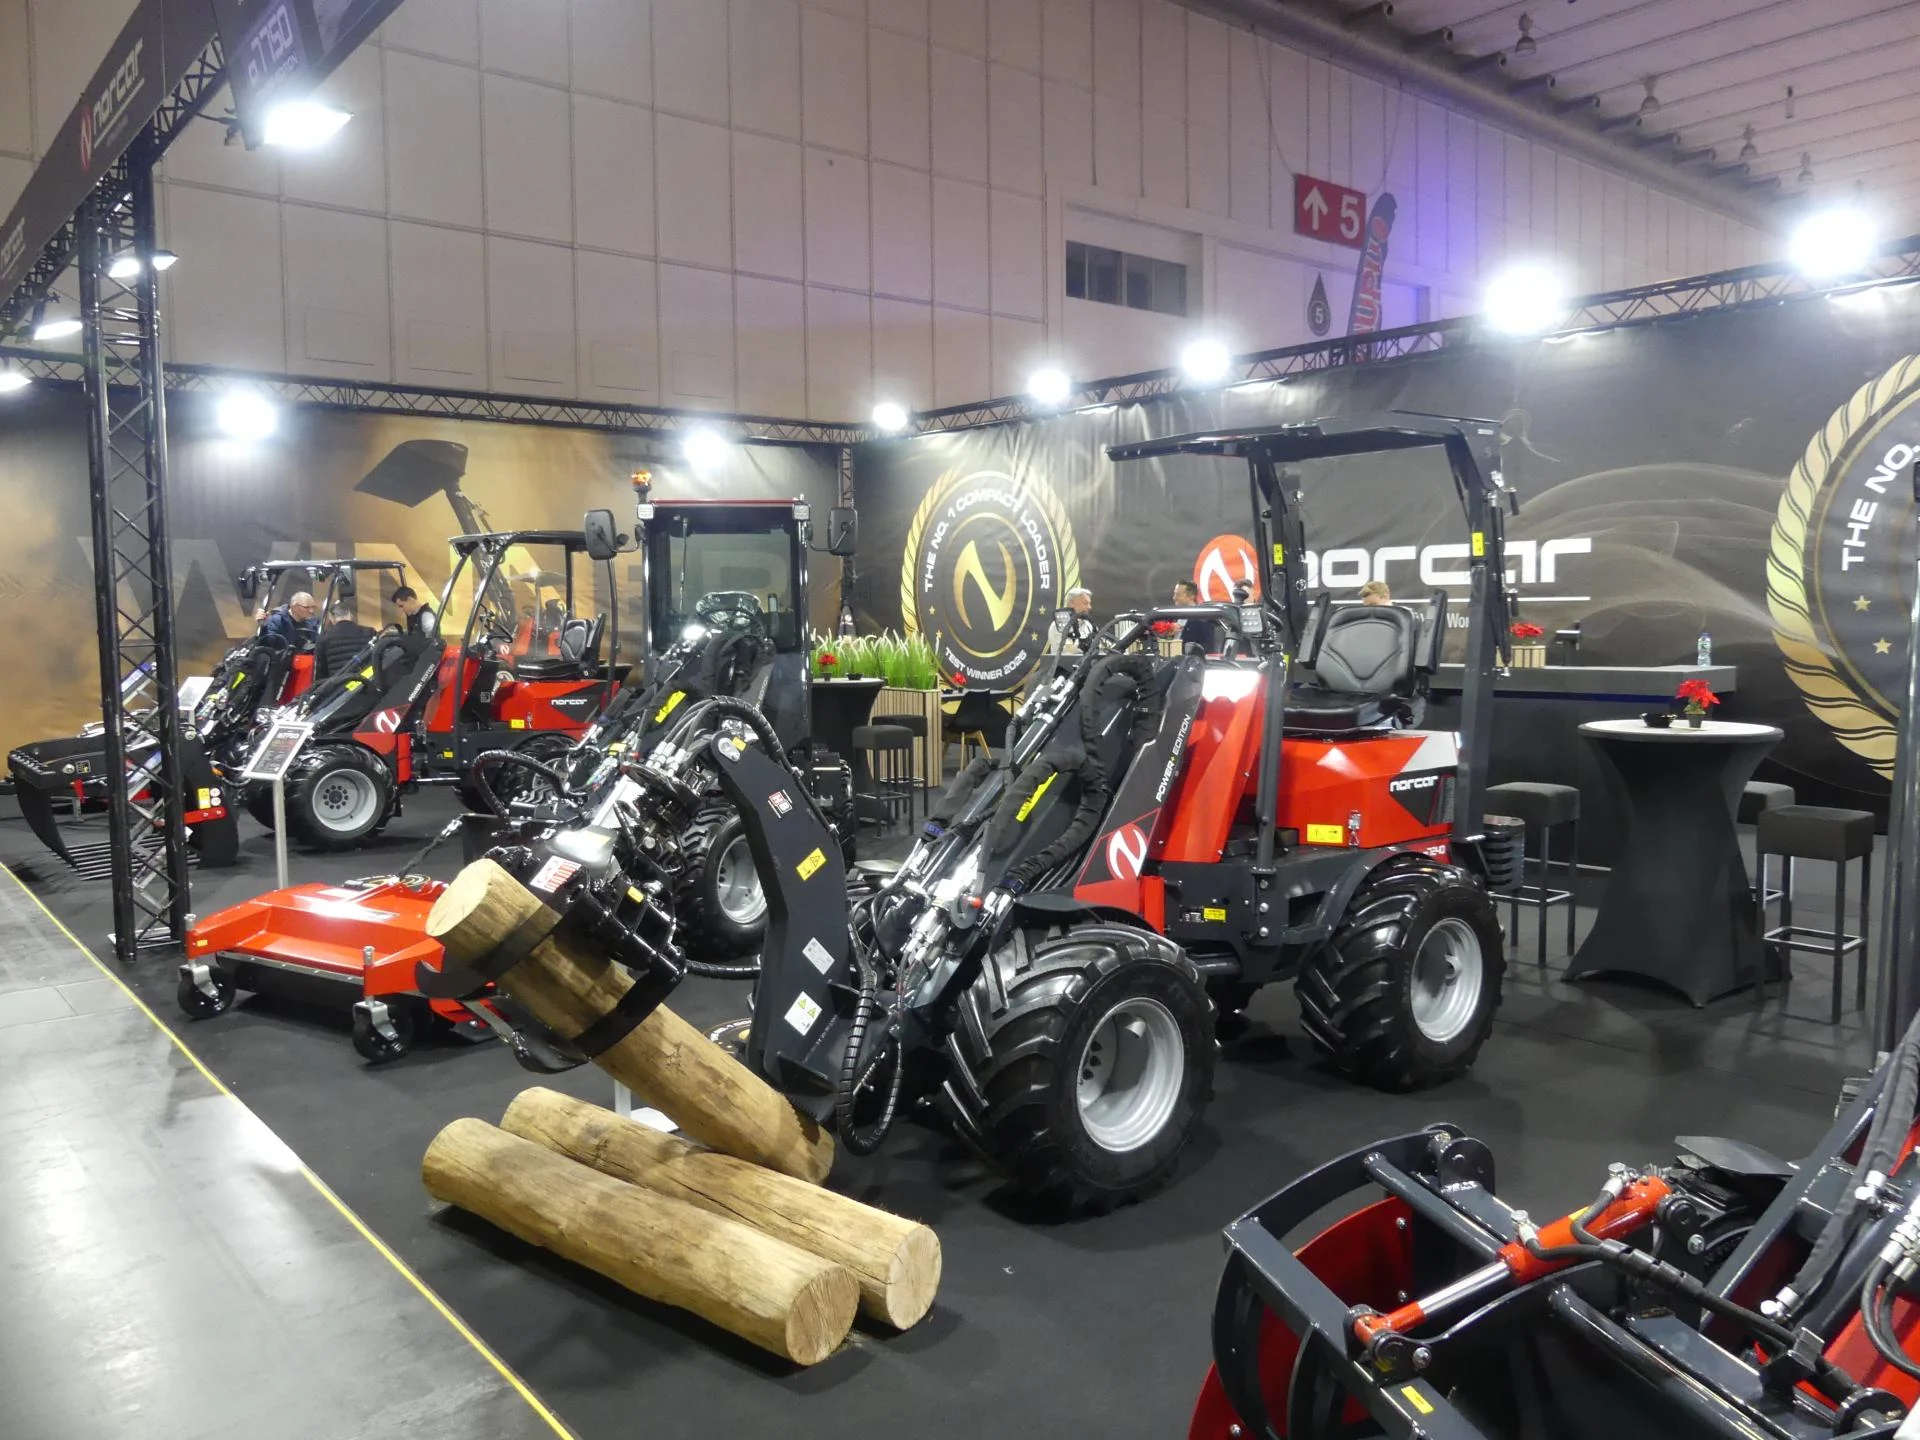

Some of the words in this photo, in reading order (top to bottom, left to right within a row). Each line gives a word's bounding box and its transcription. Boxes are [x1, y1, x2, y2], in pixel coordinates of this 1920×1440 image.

[1339, 194, 1360, 240] 5
[1314, 308, 1324, 325] 5
[924, 551, 937, 593] THE
[931, 521, 949, 550] NO.
[947, 507, 956, 518] 1
[1020, 509, 1050, 590] LOADER
[1841, 498, 1879, 571] THE
[945, 646, 966, 672] TEST
[966, 666, 1003, 680] WINNER
[1172, 713, 1192, 756] EDITION
[1389, 775, 1439, 792] norcar
